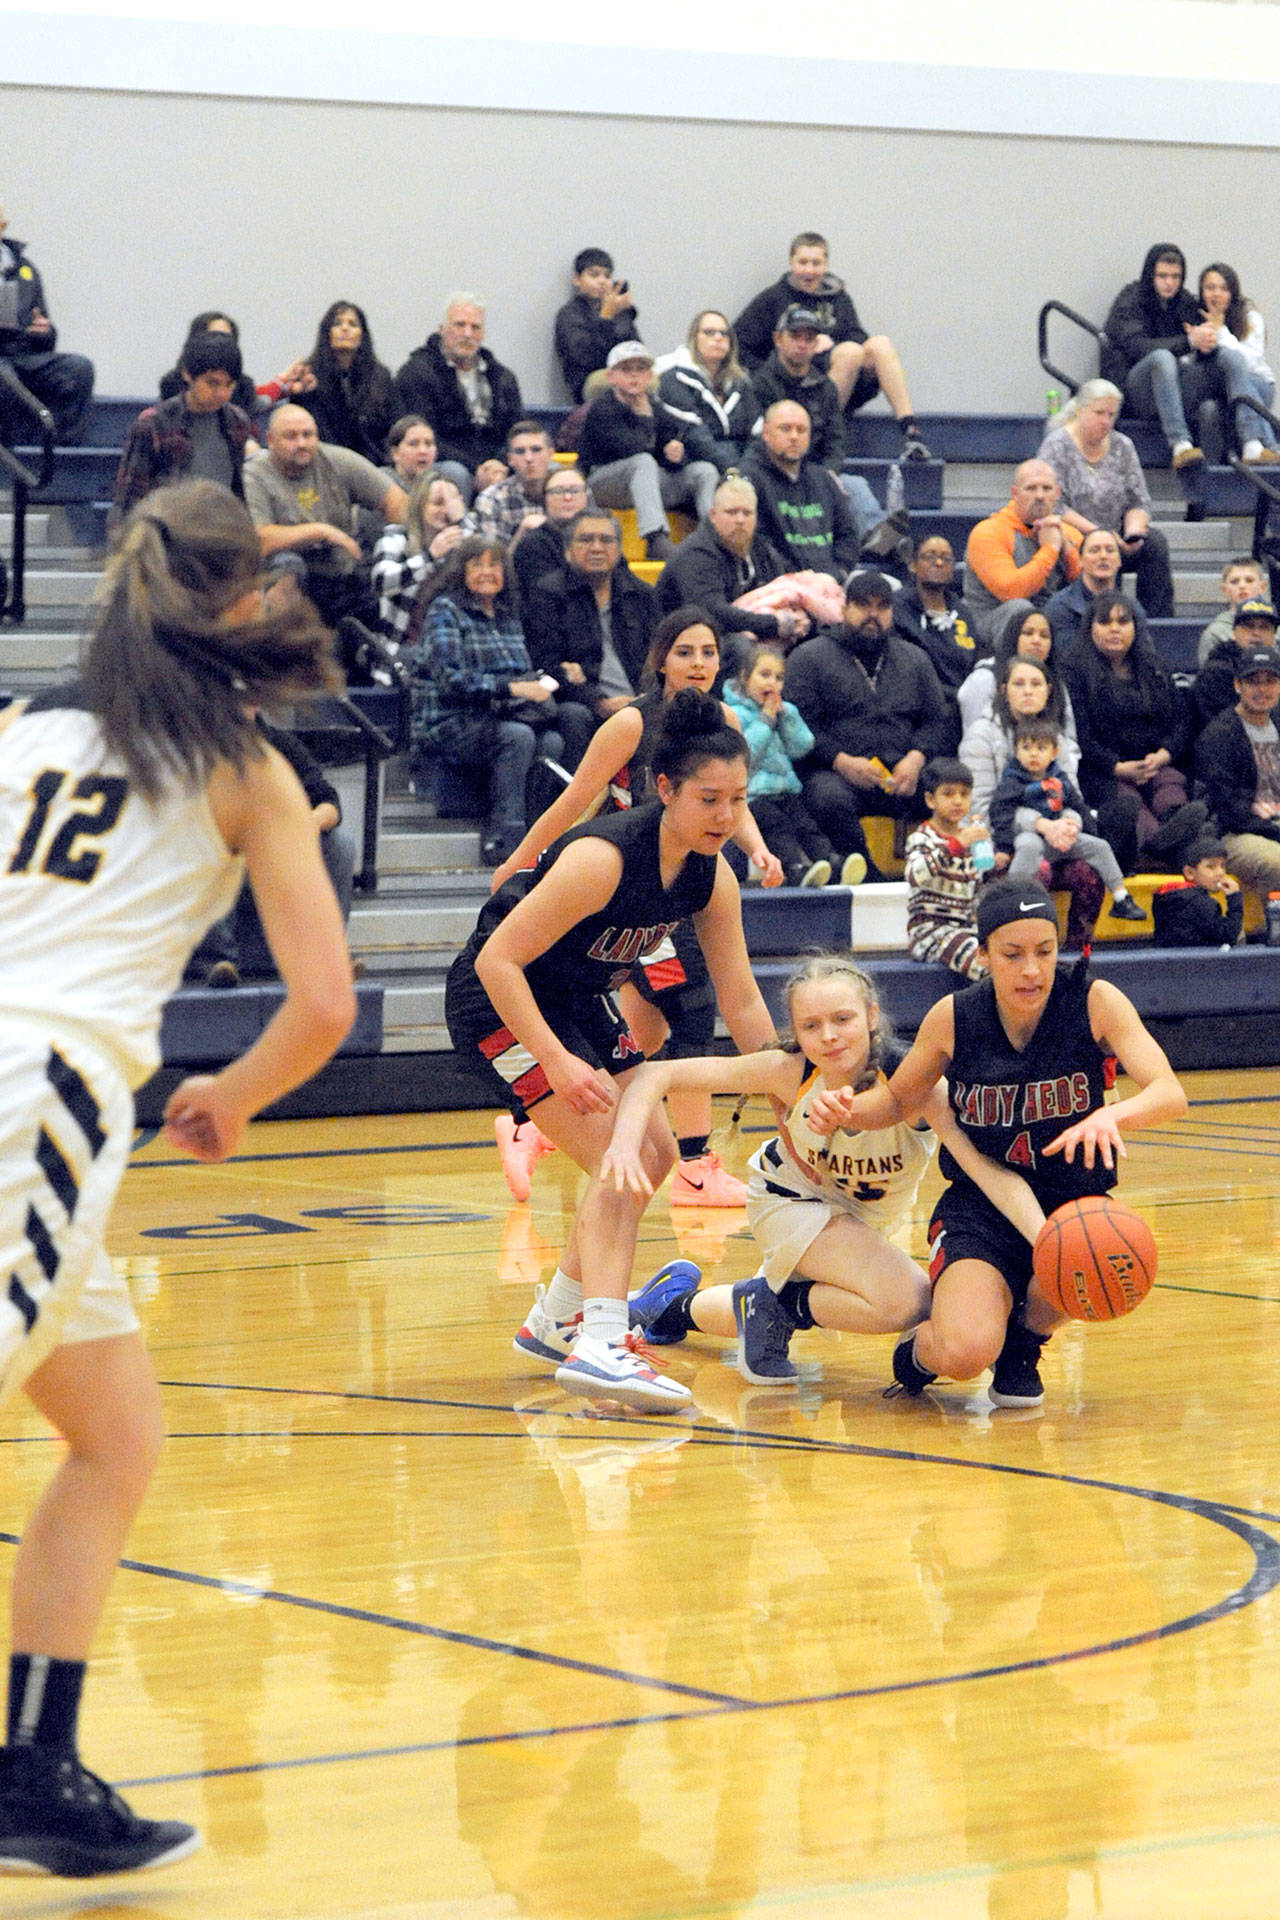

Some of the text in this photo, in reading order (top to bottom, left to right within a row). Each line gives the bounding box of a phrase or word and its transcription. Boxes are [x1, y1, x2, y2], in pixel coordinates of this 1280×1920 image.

[5, 769, 130, 884] 12
[955, 1081, 1020, 1128] LADY
[1005, 1130, 1037, 1171] 4
